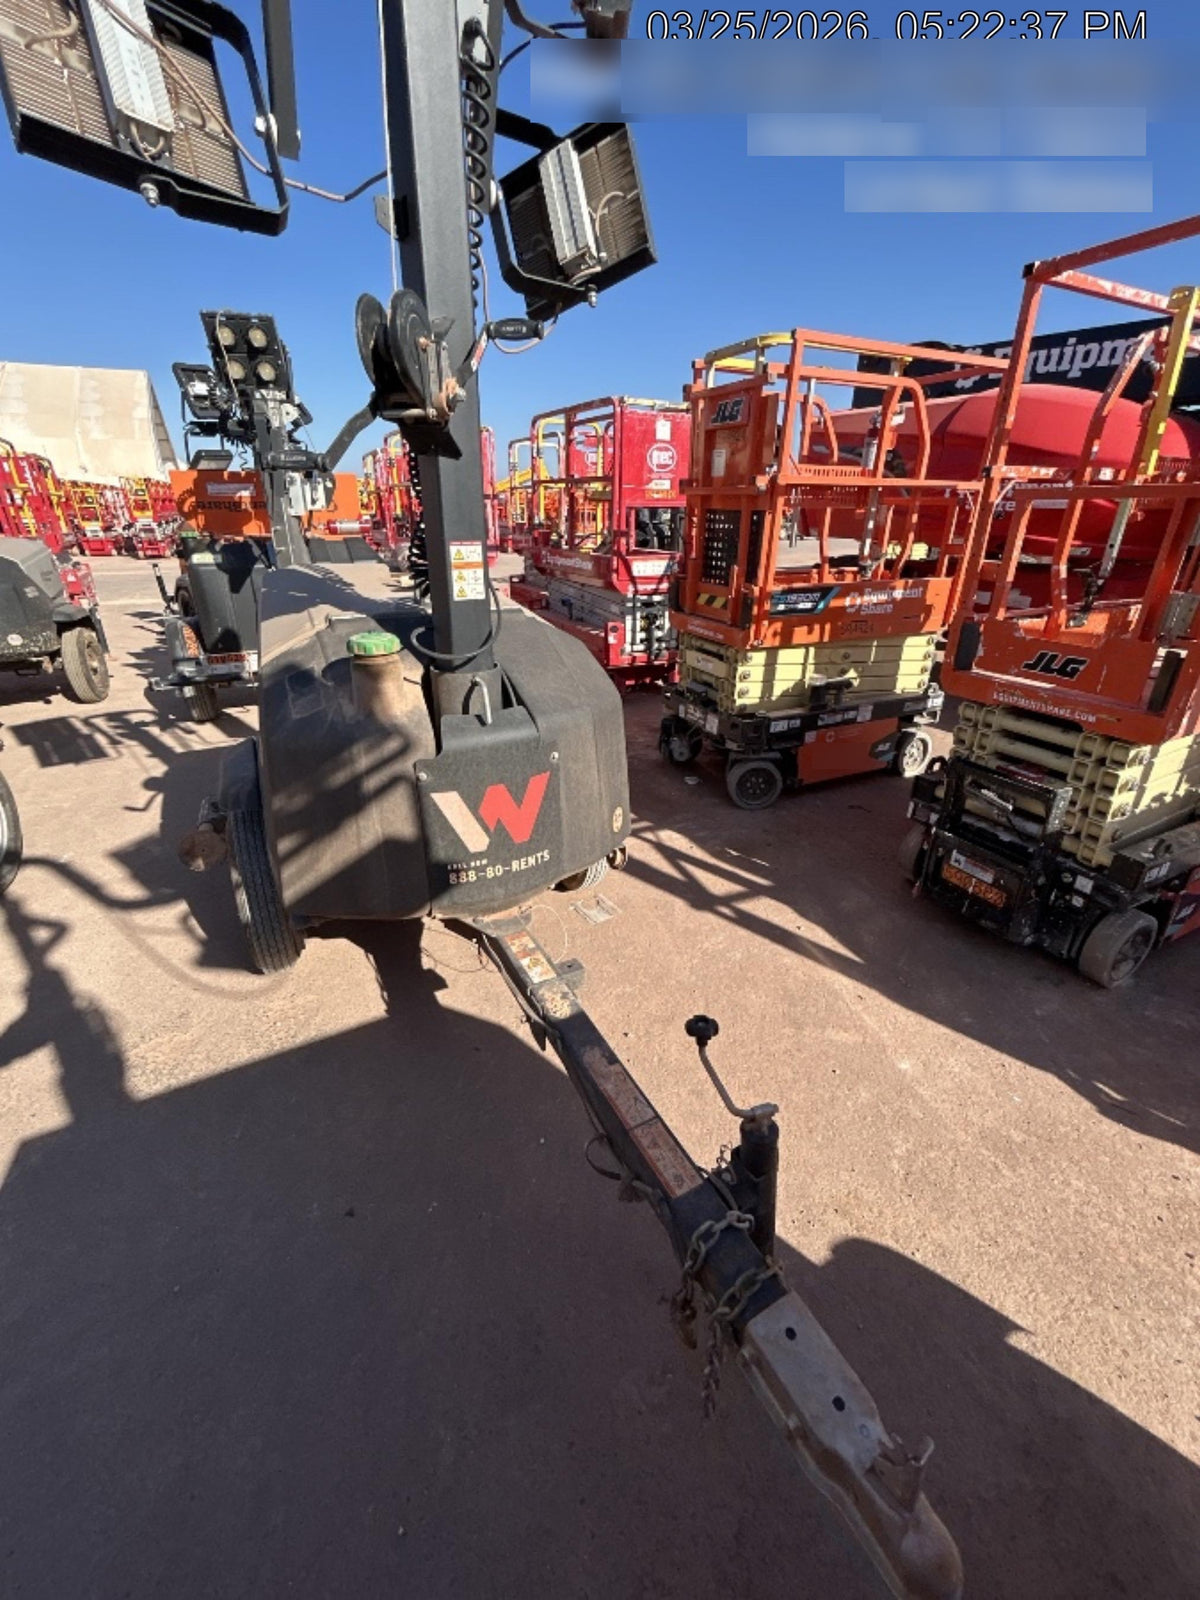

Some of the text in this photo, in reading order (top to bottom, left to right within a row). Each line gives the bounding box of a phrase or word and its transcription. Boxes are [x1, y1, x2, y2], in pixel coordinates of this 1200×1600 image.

[711, 398, 744, 424] JLG
[1021, 650, 1090, 681] JLG
[448, 849, 551, 884] 888-80-RENTS
